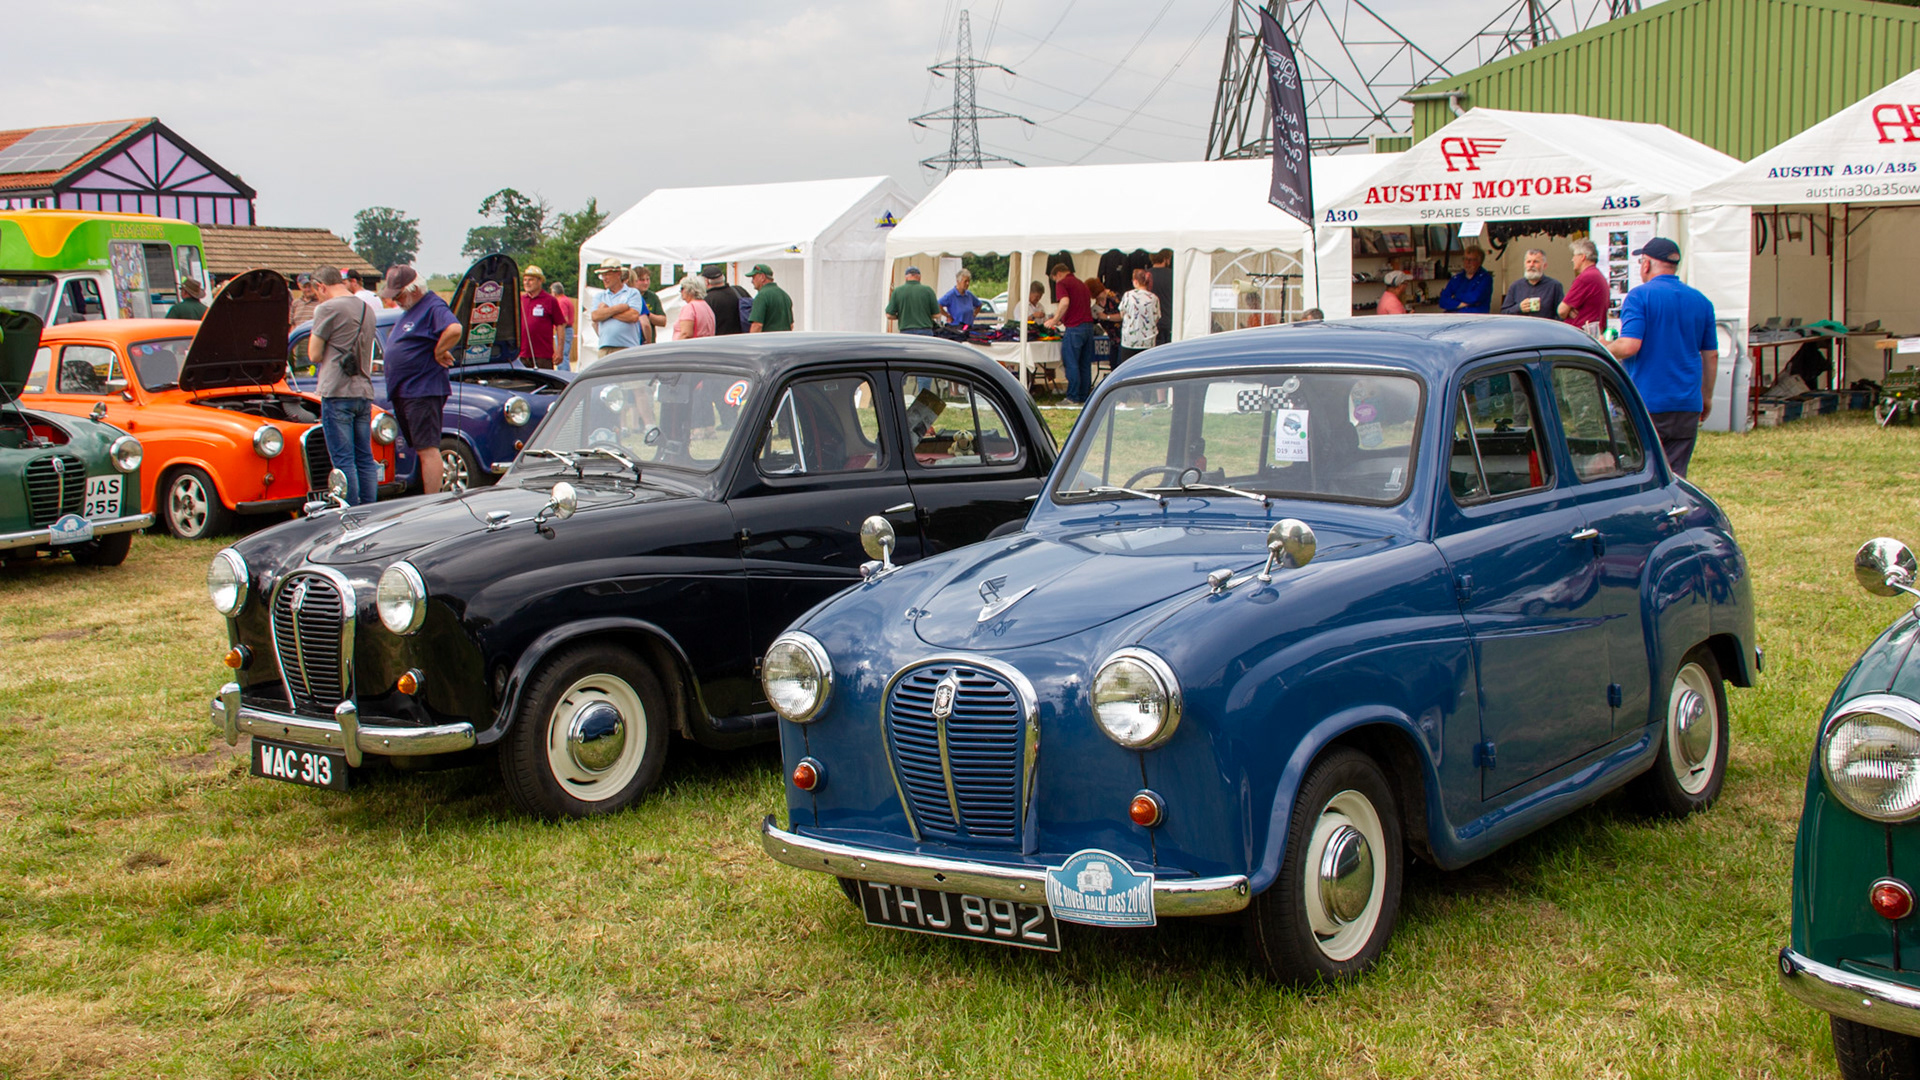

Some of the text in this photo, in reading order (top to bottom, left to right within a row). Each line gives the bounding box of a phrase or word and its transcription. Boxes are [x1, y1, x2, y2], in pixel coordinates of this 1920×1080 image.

[1768, 162, 1917, 179] AUSTIN A30/A35
[1364, 174, 1593, 205] AUSTIN MOTORS
[1420, 204, 1531, 219] SPARES SERVICE
[1601, 195, 1641, 211] A35
[1324, 209, 1359, 223] A30
[87, 479, 120, 497] JAS
[85, 500, 119, 517] 255
[261, 745, 333, 786] WAC 313
[1062, 884, 1085, 910] RIVER
[1085, 894, 1107, 911] RALLY
[1107, 891, 1126, 913] DISS
[1127, 880, 1148, 913] 2018
[868, 881, 1048, 942] THJ 892
